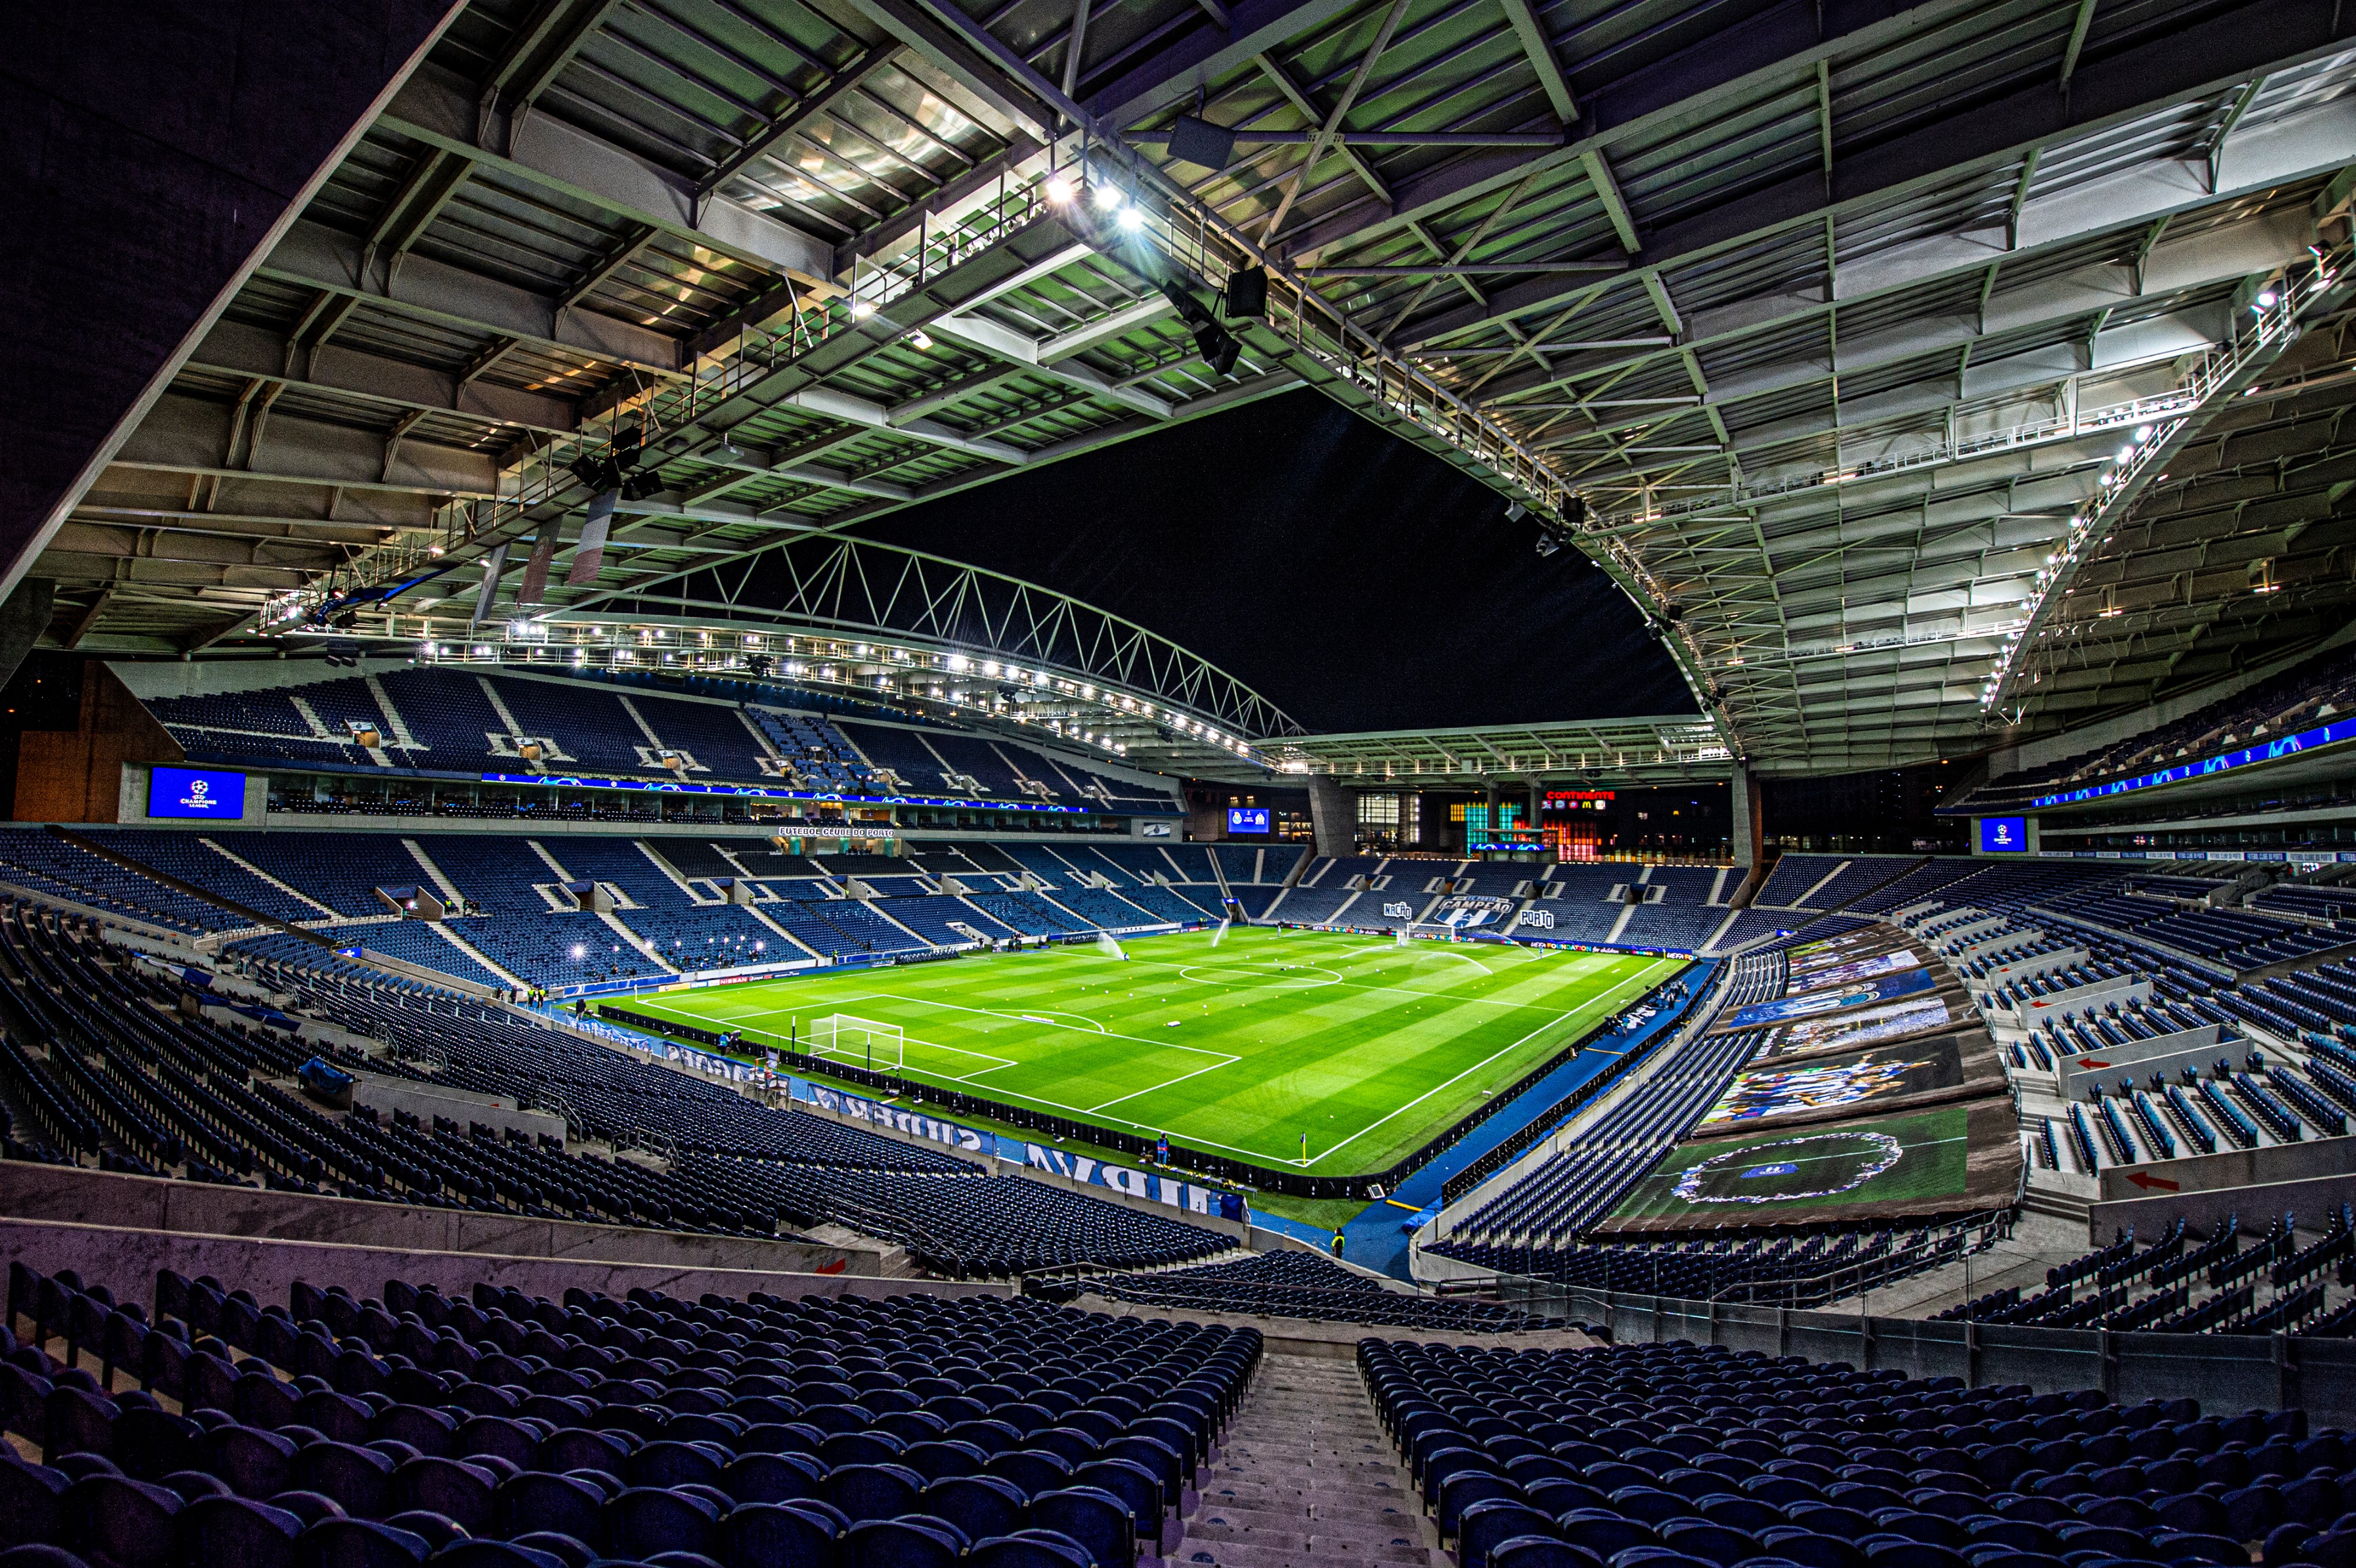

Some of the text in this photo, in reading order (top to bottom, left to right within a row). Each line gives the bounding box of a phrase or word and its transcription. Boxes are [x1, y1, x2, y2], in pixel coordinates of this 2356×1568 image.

[779, 827, 820, 835] FUTEBOL
[822, 828, 851, 836] CLUBE
[867, 829, 894, 837] PORTO
[1521, 910, 1554, 928] PORTO
[1547, 943, 1592, 951] FOUNDATION
